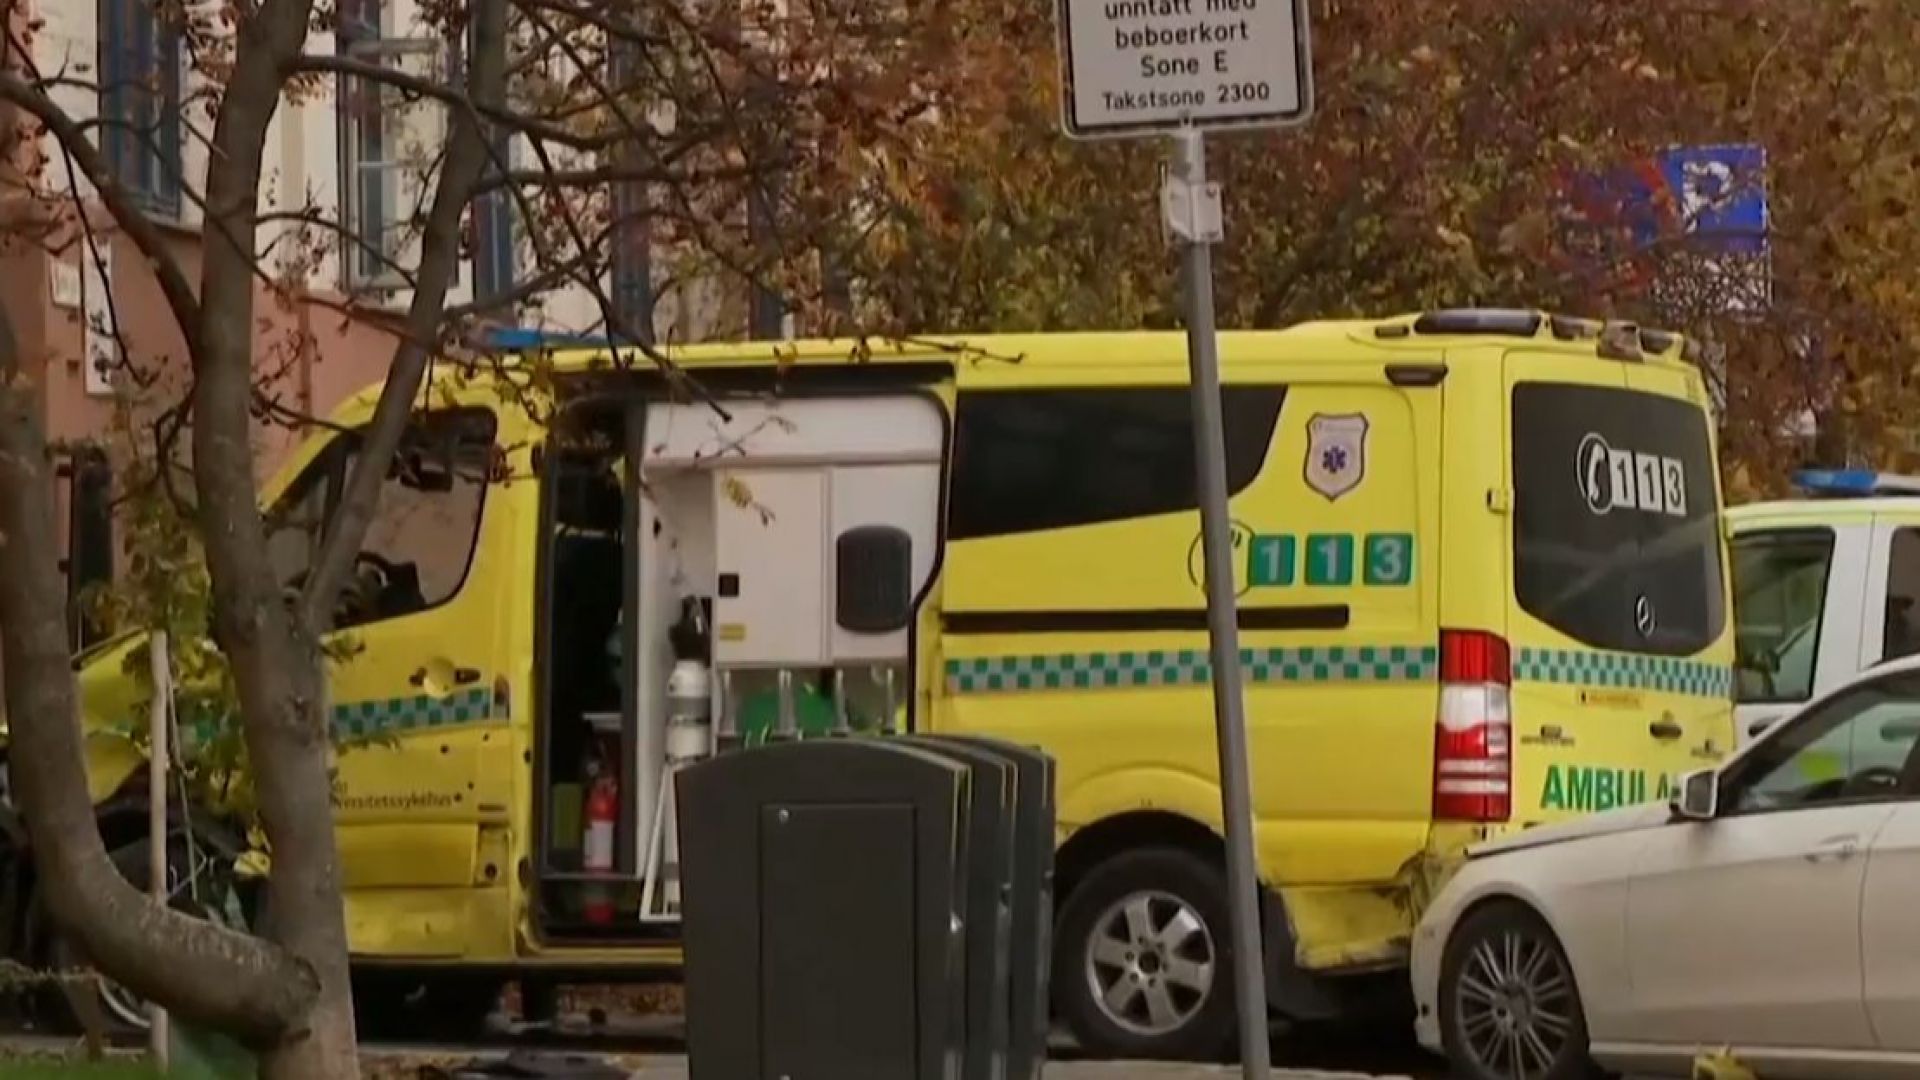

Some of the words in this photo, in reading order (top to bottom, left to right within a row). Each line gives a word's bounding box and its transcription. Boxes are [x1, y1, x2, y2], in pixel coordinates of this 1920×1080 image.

[1115, 18, 1249, 49] beboerkort
[1141, 55, 1199, 78] Sone
[1214, 51, 1229, 73] E
[1102, 88, 1205, 111] Takstsone
[1217, 81, 1270, 104] 2300
[1616, 456, 1682, 508] 113
[1540, 764, 1672, 813] AMBULA
